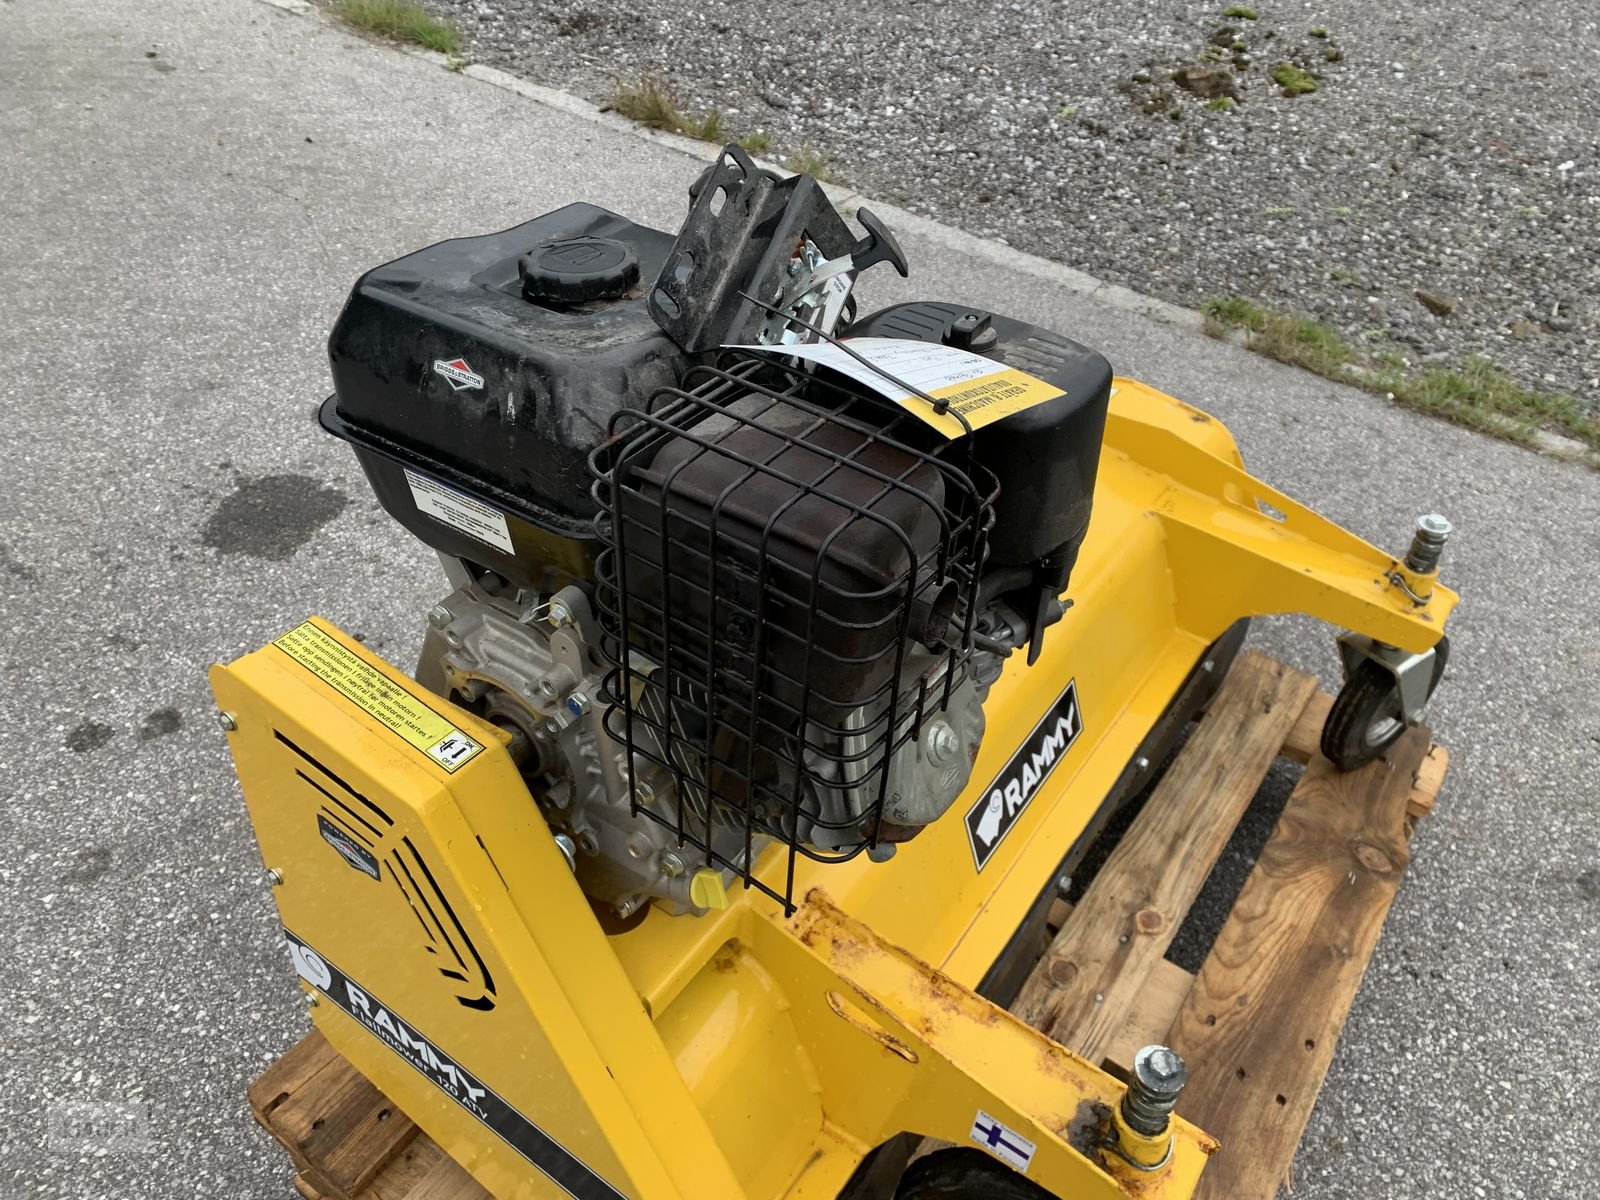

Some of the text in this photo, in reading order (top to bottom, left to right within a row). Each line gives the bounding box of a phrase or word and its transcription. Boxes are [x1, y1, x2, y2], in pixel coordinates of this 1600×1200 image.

[301, 624, 322, 638] Ennen
[277, 639, 300, 655] Before
[296, 653, 322, 671] starting
[319, 669, 333, 679] the
[330, 677, 370, 706] transmission
[285, 634, 304, 647] Sette
[299, 646, 314, 656] opp
[311, 653, 345, 677] sendingen
[377, 700, 405, 721] motoren
[403, 719, 428, 737] startes
[308, 639, 354, 672] transmissionen
[392, 699, 417, 717] motorn
[440, 756, 454, 766] OFF
[1004, 701, 1075, 818] RAMMY
[345, 980, 486, 1103] RAMMY
[437, 1075, 459, 1096] 120
[462, 1096, 488, 1120] ATV
